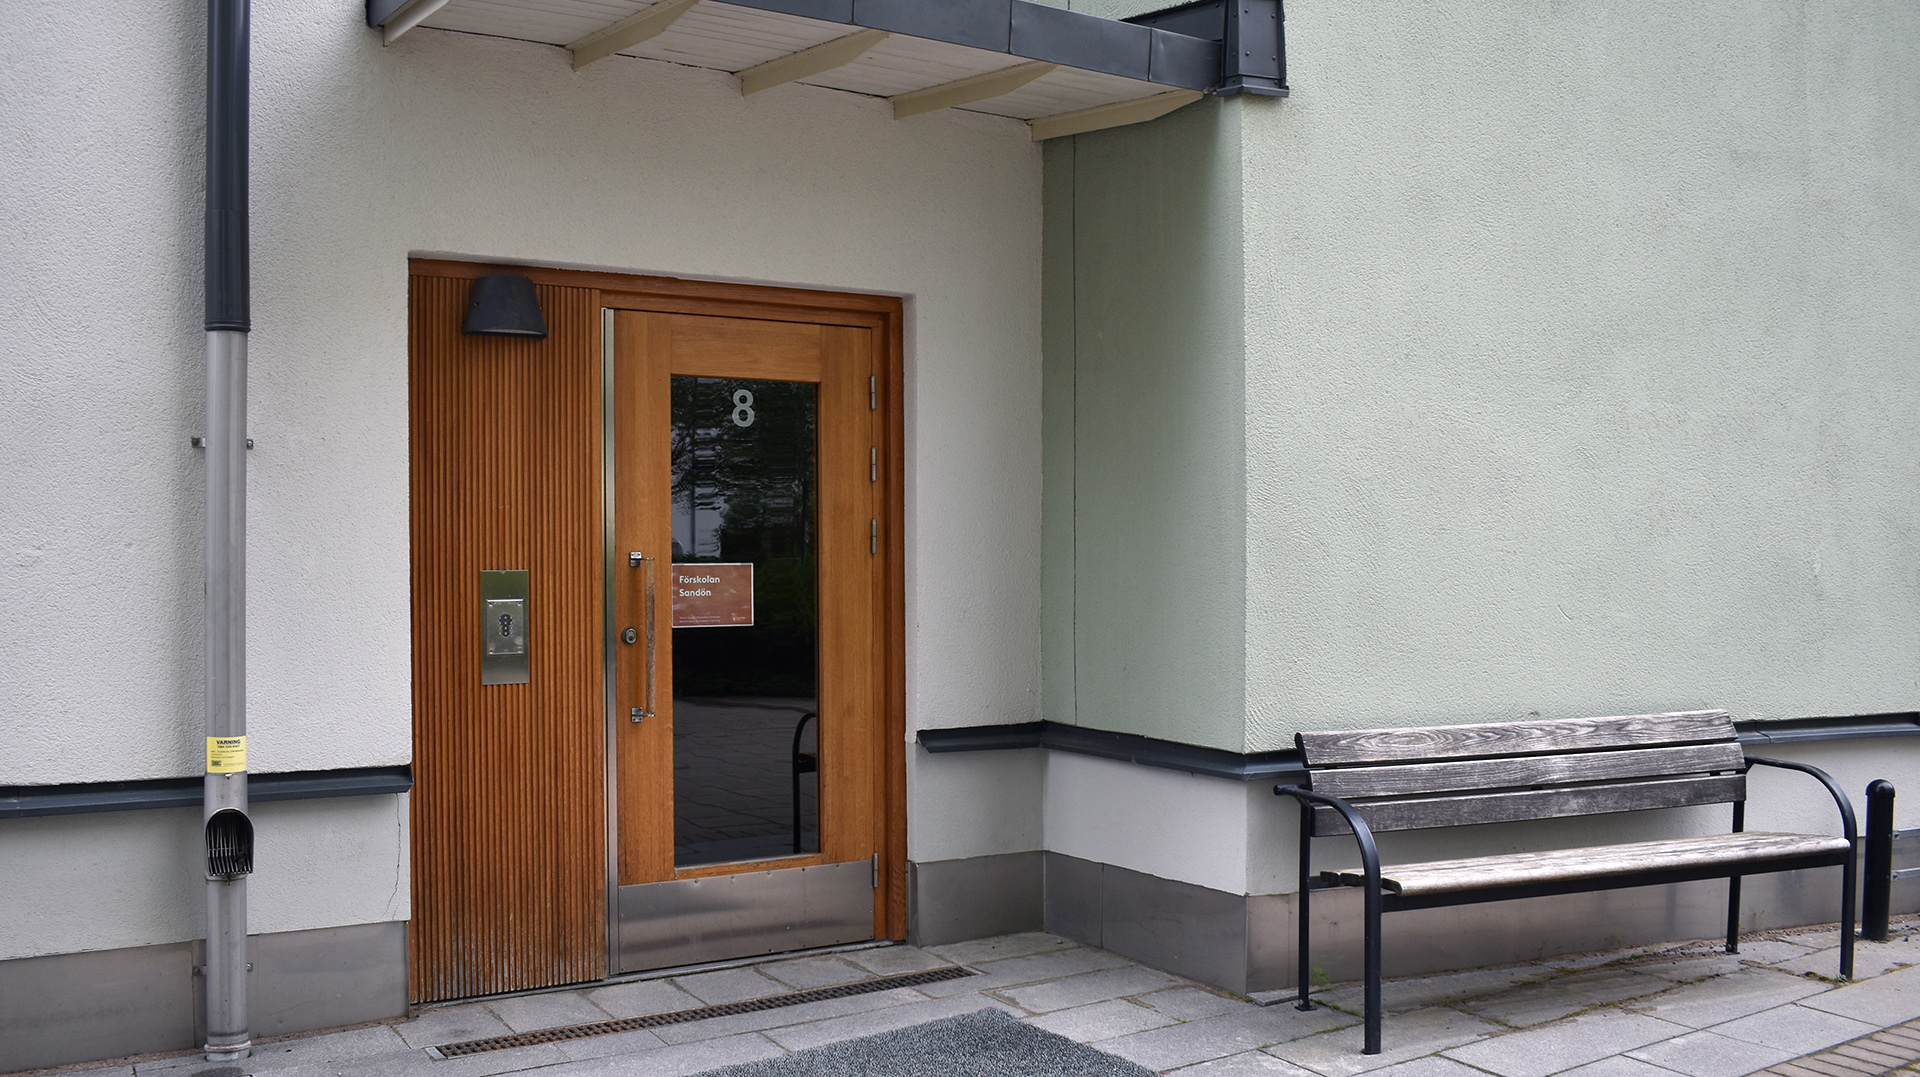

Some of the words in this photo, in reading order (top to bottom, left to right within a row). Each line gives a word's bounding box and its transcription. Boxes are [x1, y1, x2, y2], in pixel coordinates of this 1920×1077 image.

[732, 389, 755, 428] 8
[679, 575, 720, 583] Förskolan
[679, 588, 711, 597] Sandön
